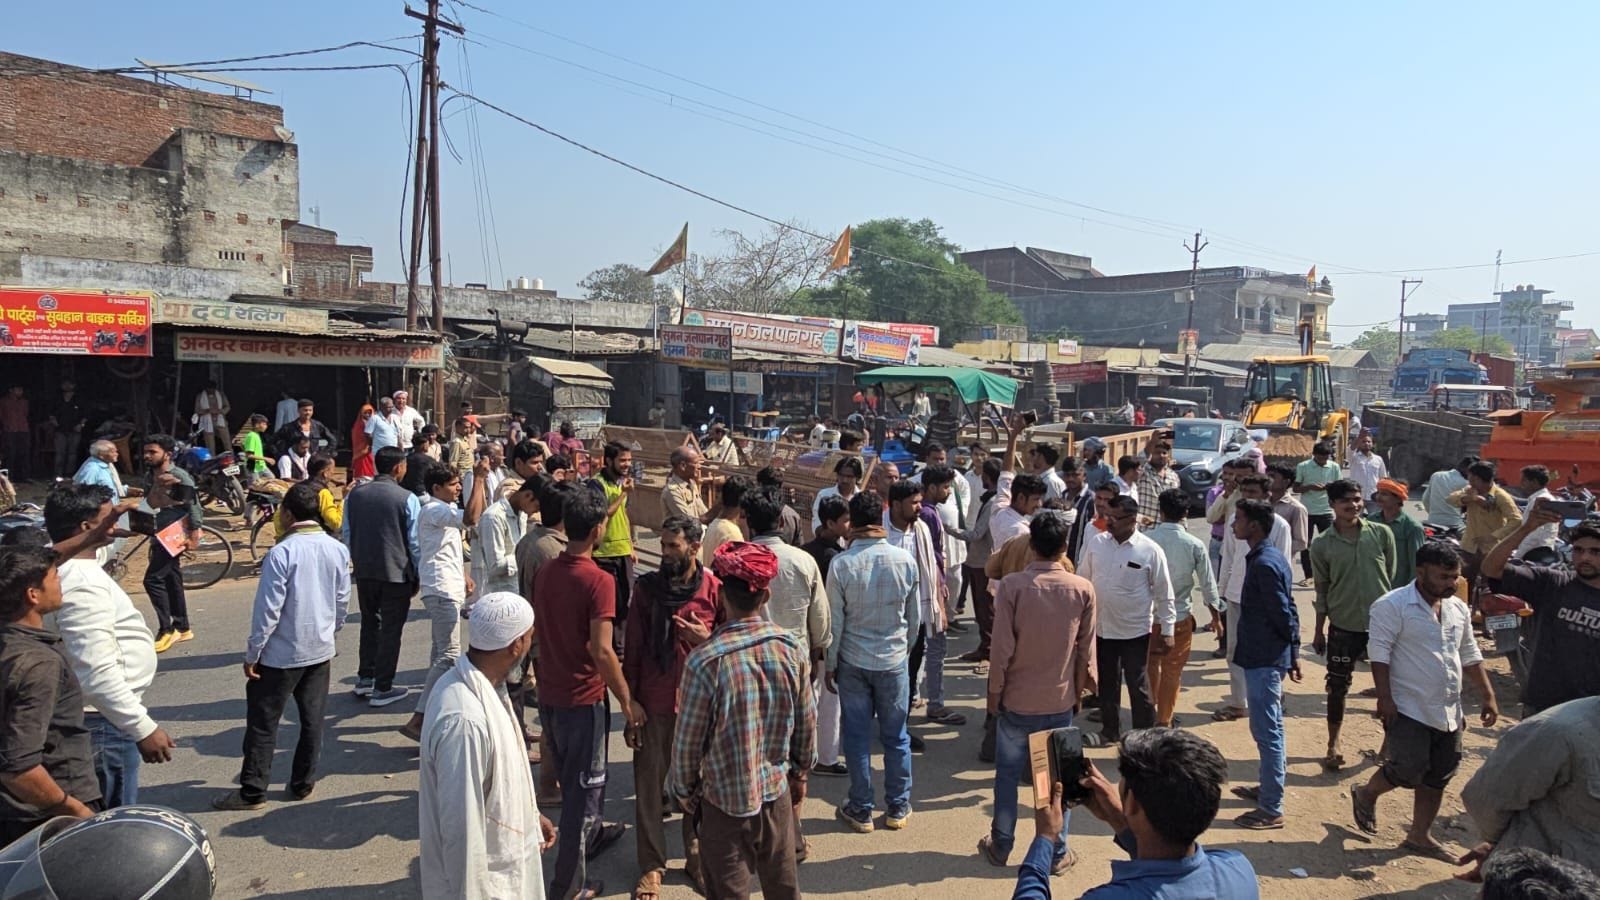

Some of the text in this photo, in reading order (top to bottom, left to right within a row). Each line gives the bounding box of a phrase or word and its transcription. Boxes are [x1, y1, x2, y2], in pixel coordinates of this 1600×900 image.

[7, 305, 37, 326] पार्ट्स
[117, 310, 147, 326] सर्विस
[179, 336, 237, 352] अनवर
